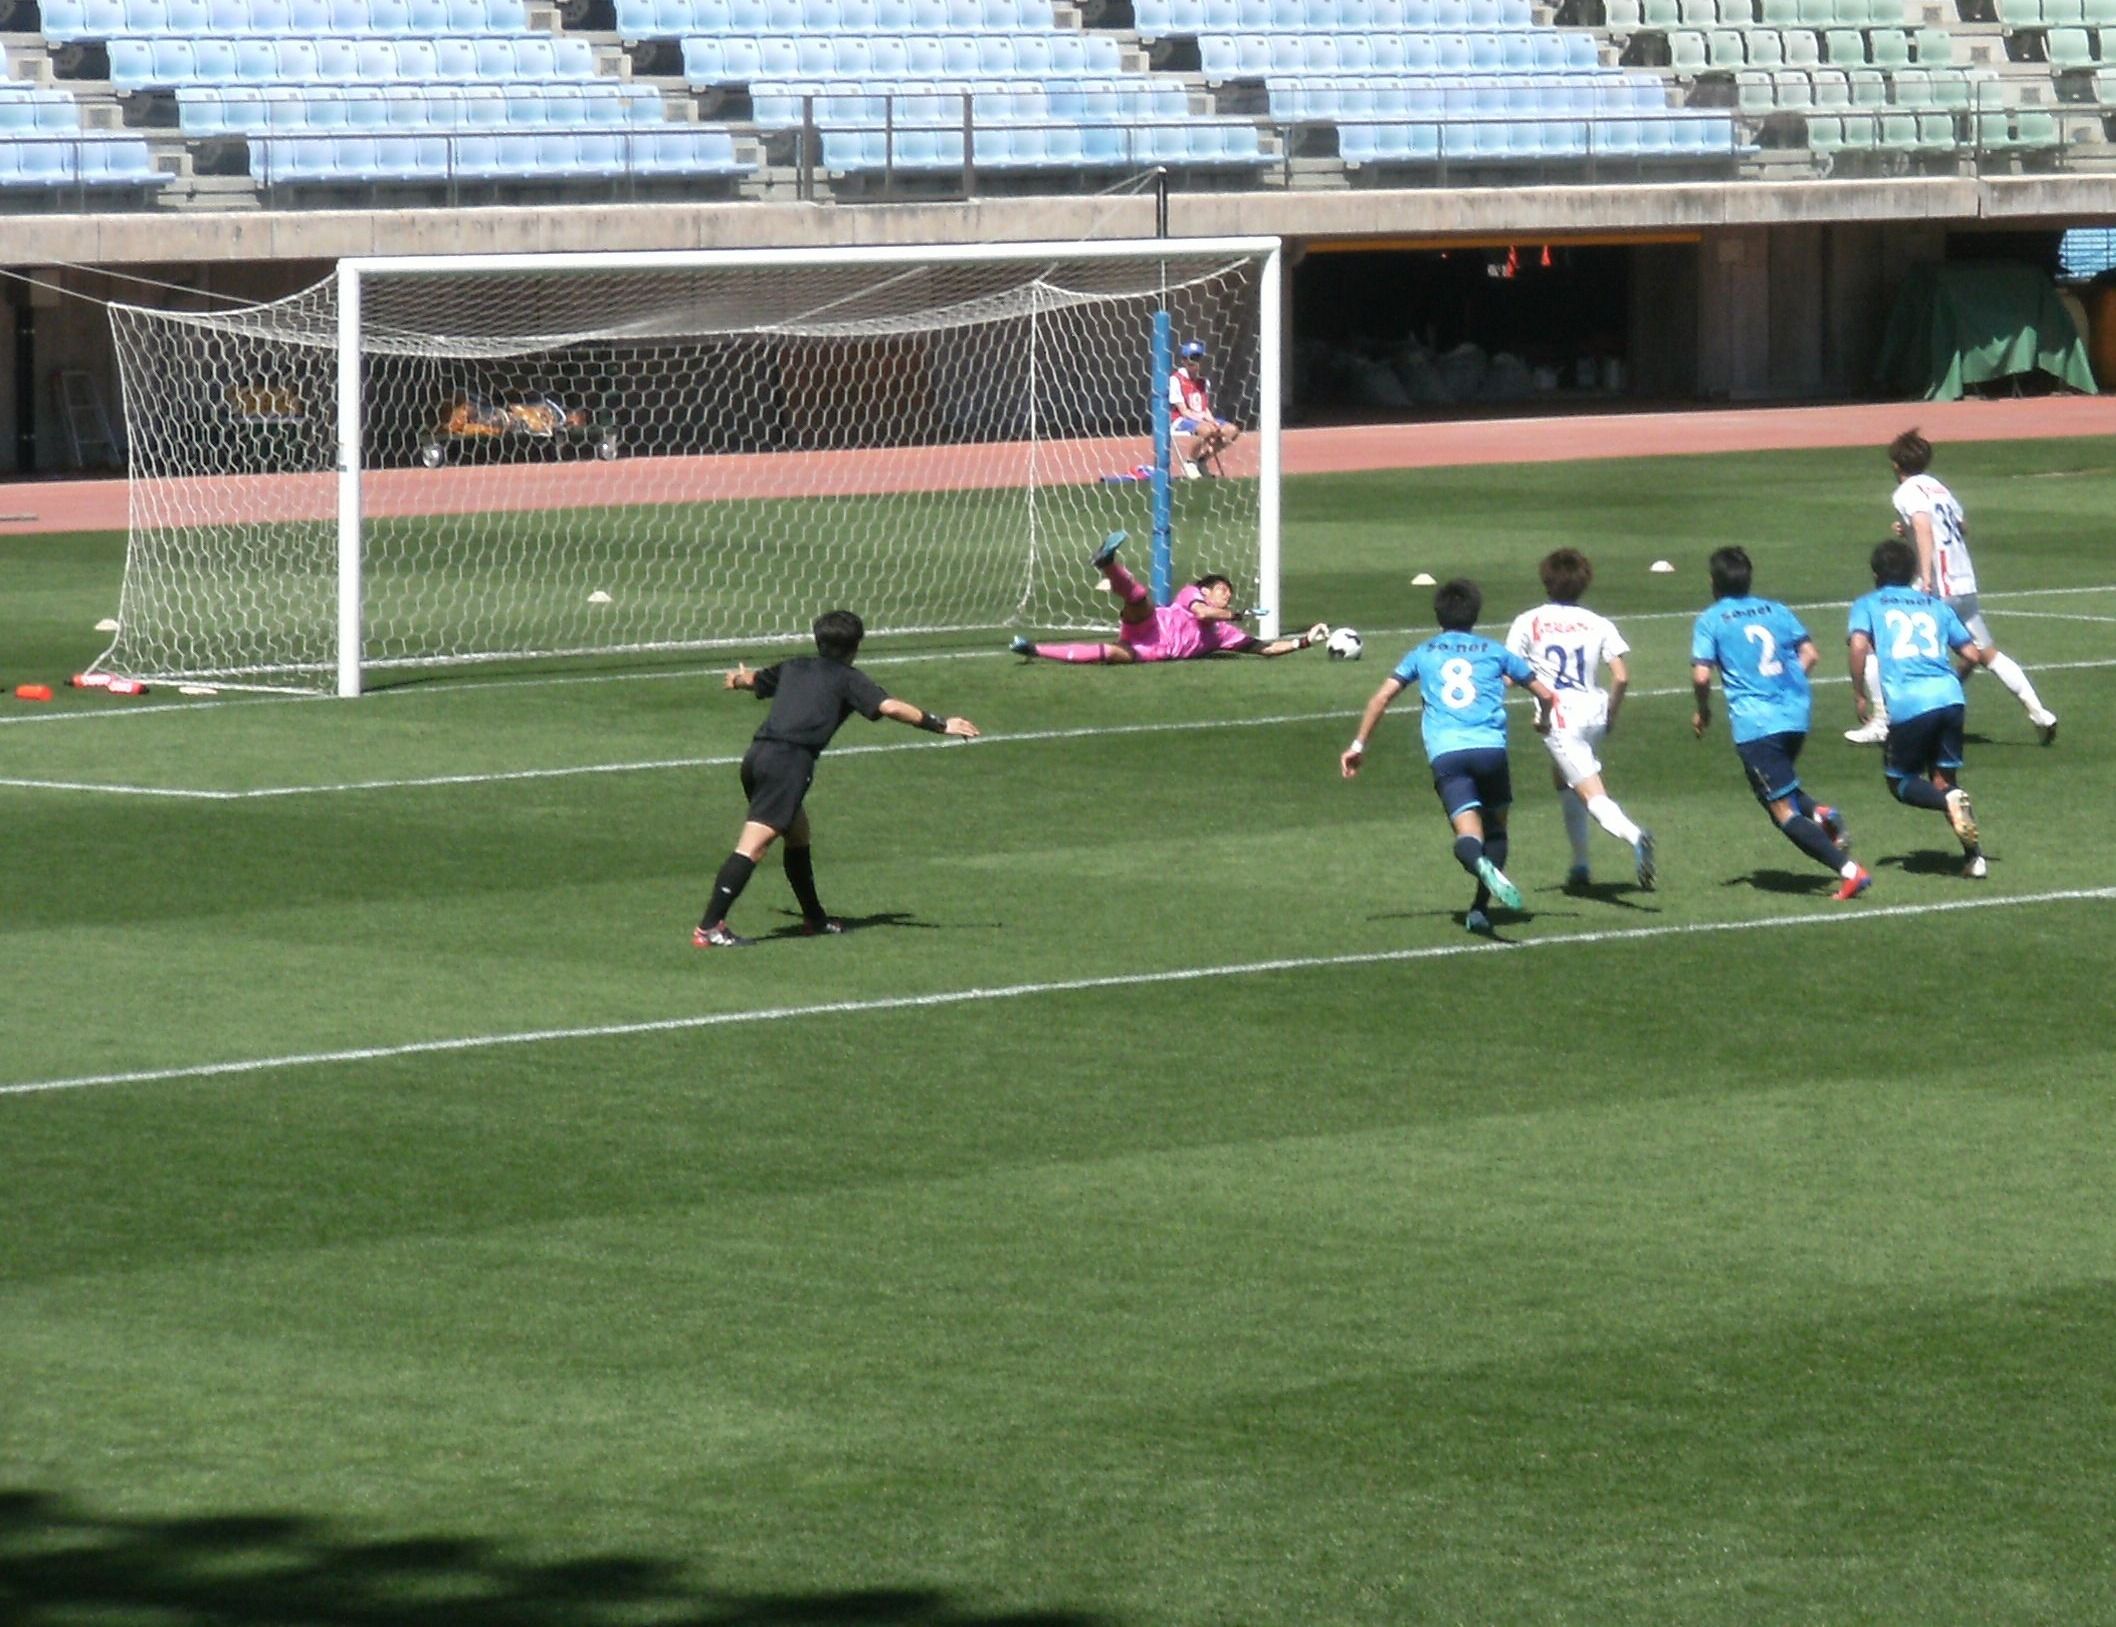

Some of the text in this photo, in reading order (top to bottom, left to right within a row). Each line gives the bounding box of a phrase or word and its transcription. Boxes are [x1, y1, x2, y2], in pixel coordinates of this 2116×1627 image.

[1744, 624, 1783, 677] 2
[1884, 609, 1940, 659] 23
[1440, 657, 1476, 709] 8
[1545, 644, 1586, 690] 21
